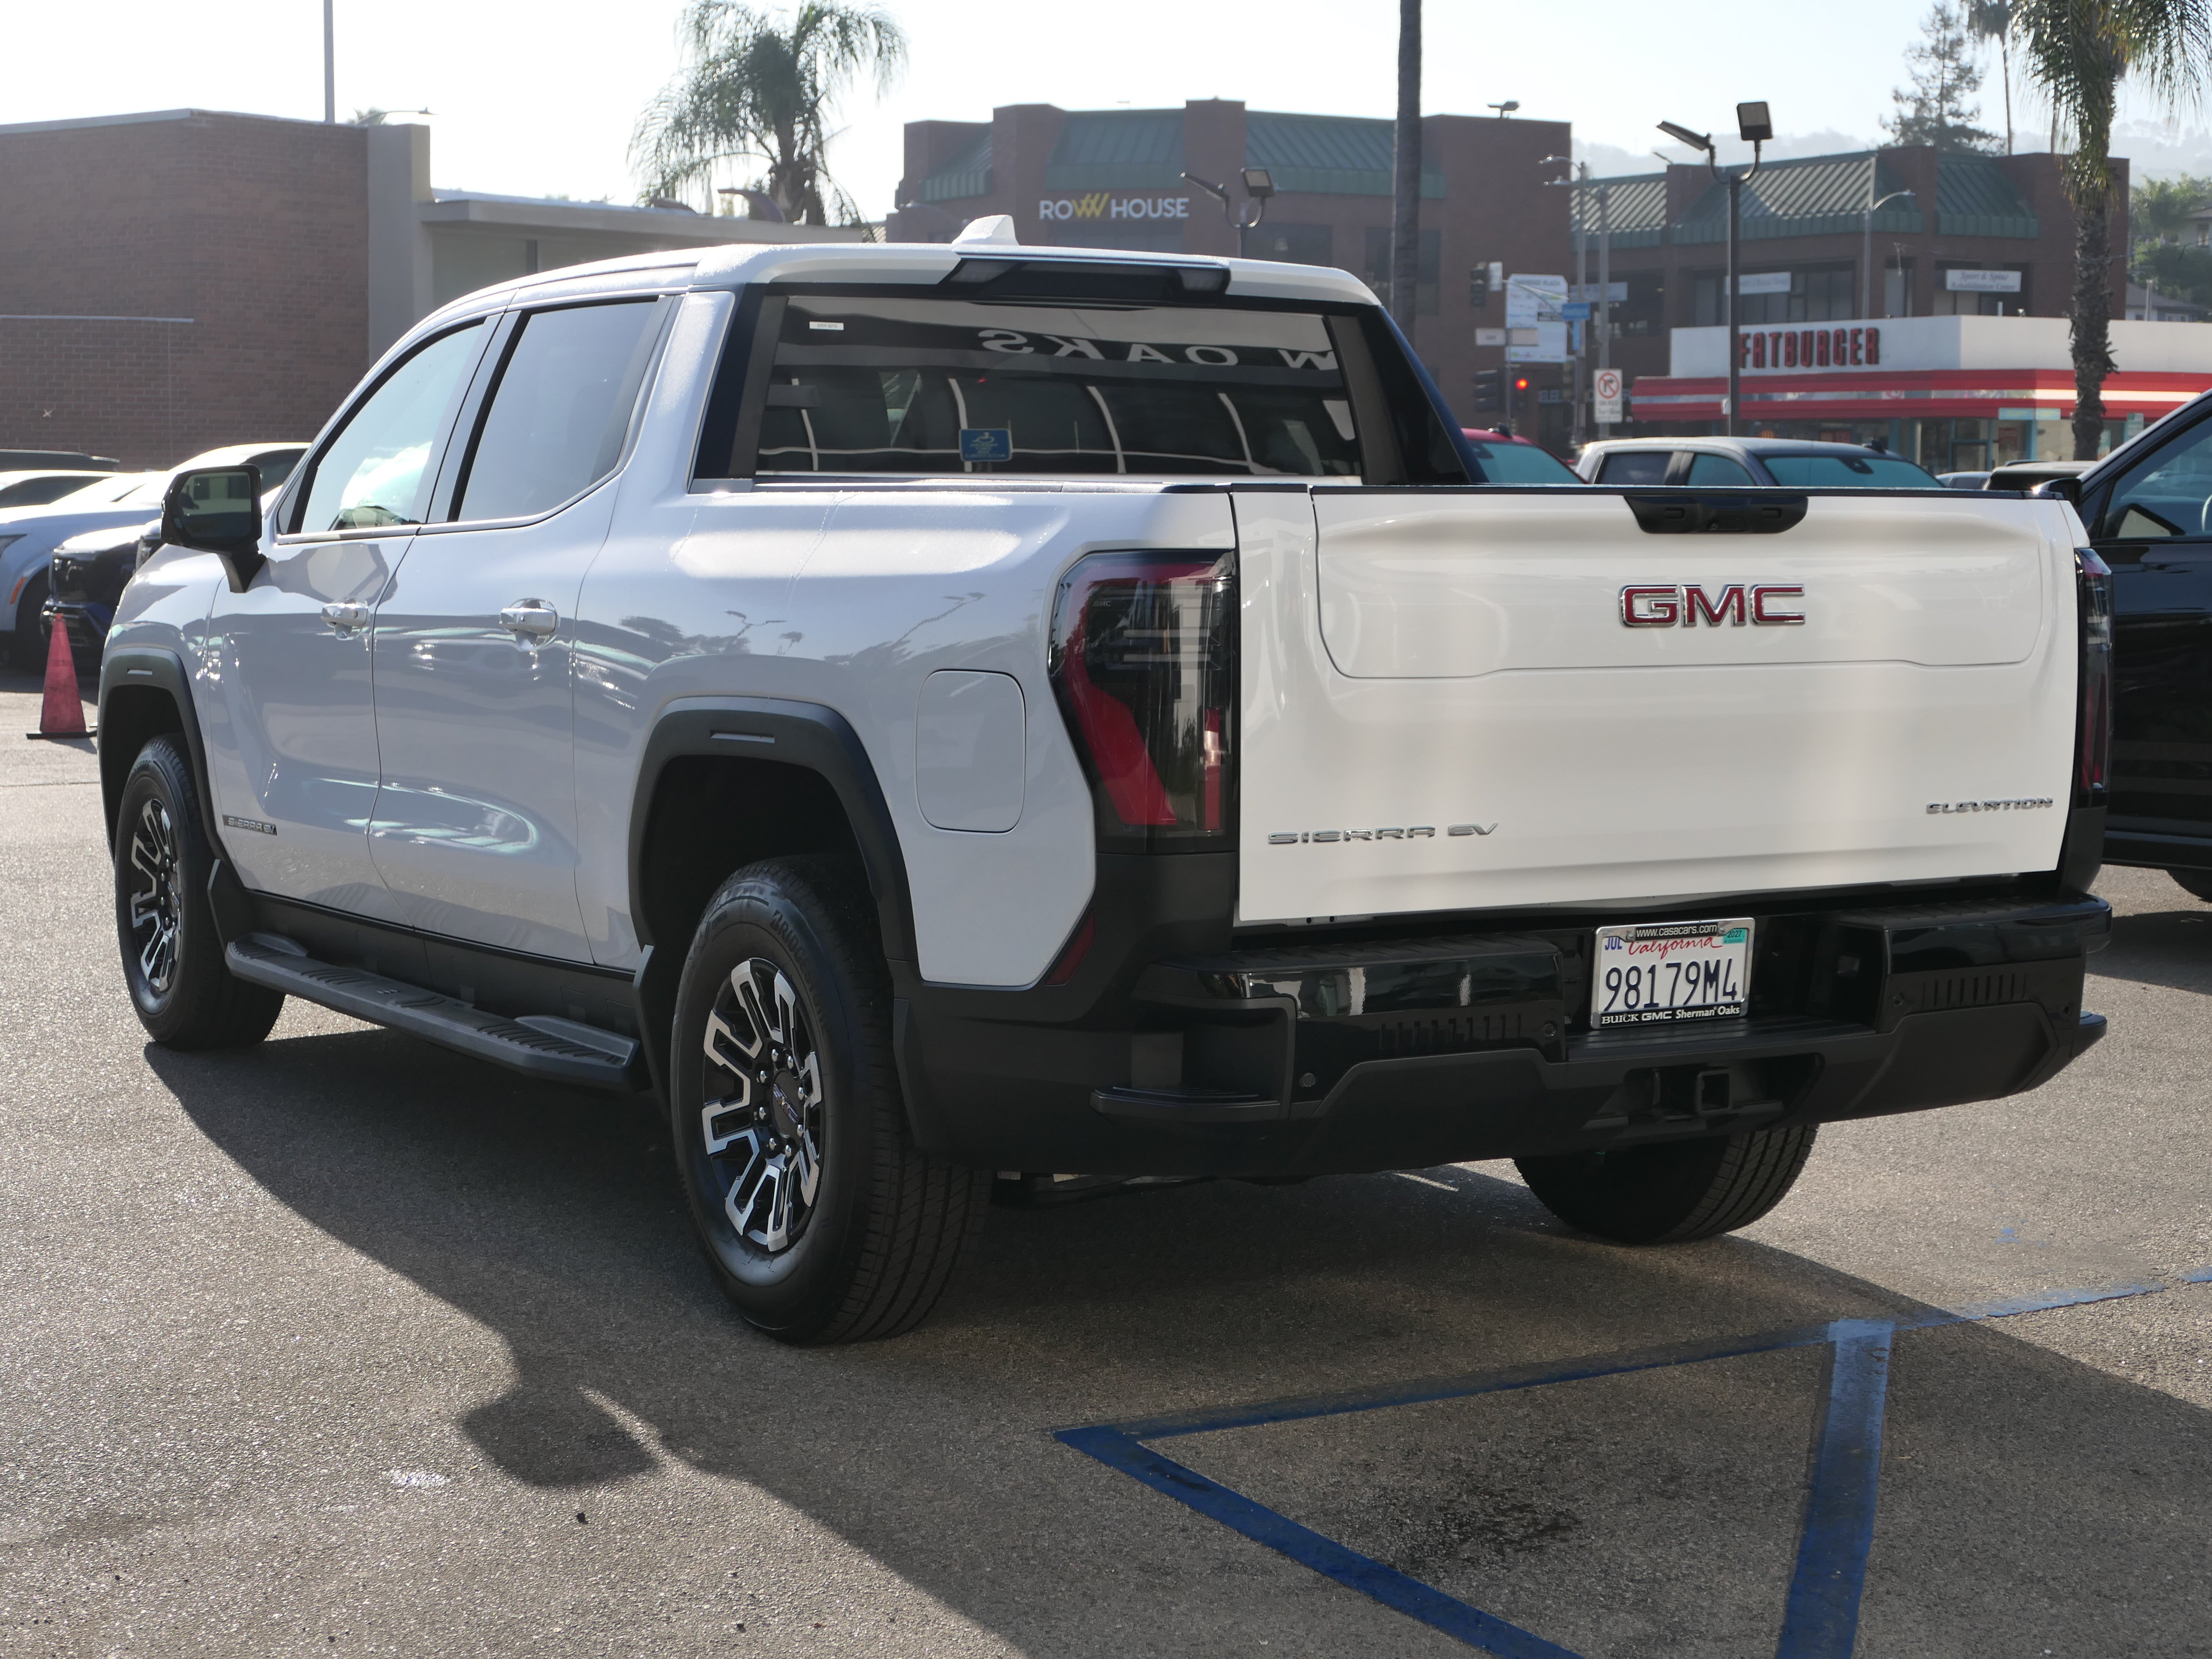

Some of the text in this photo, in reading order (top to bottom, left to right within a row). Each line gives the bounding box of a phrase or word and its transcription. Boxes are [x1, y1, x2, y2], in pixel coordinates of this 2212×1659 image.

[1111, 197, 1190, 218] HOUSE
[1961, 272, 1979, 282] Sport
[1990, 273, 2009, 282] Spine
[1739, 327, 1880, 368] FATBURGER
[1619, 583, 1805, 628] GMC
[1926, 797, 2053, 814] ELEVATION
[228, 817, 275, 834] SIERRA EV
[1267, 822, 1499, 845] SIERRA EV
[1605, 930, 1742, 950] JUL 2027
[1636, 925, 1718, 937] www.casacars.com
[1629, 937, 1723, 960] California
[1604, 958, 1737, 1012] 98179M4
[1602, 1005, 1740, 1024] BUICK GMC Sherman Oaks
